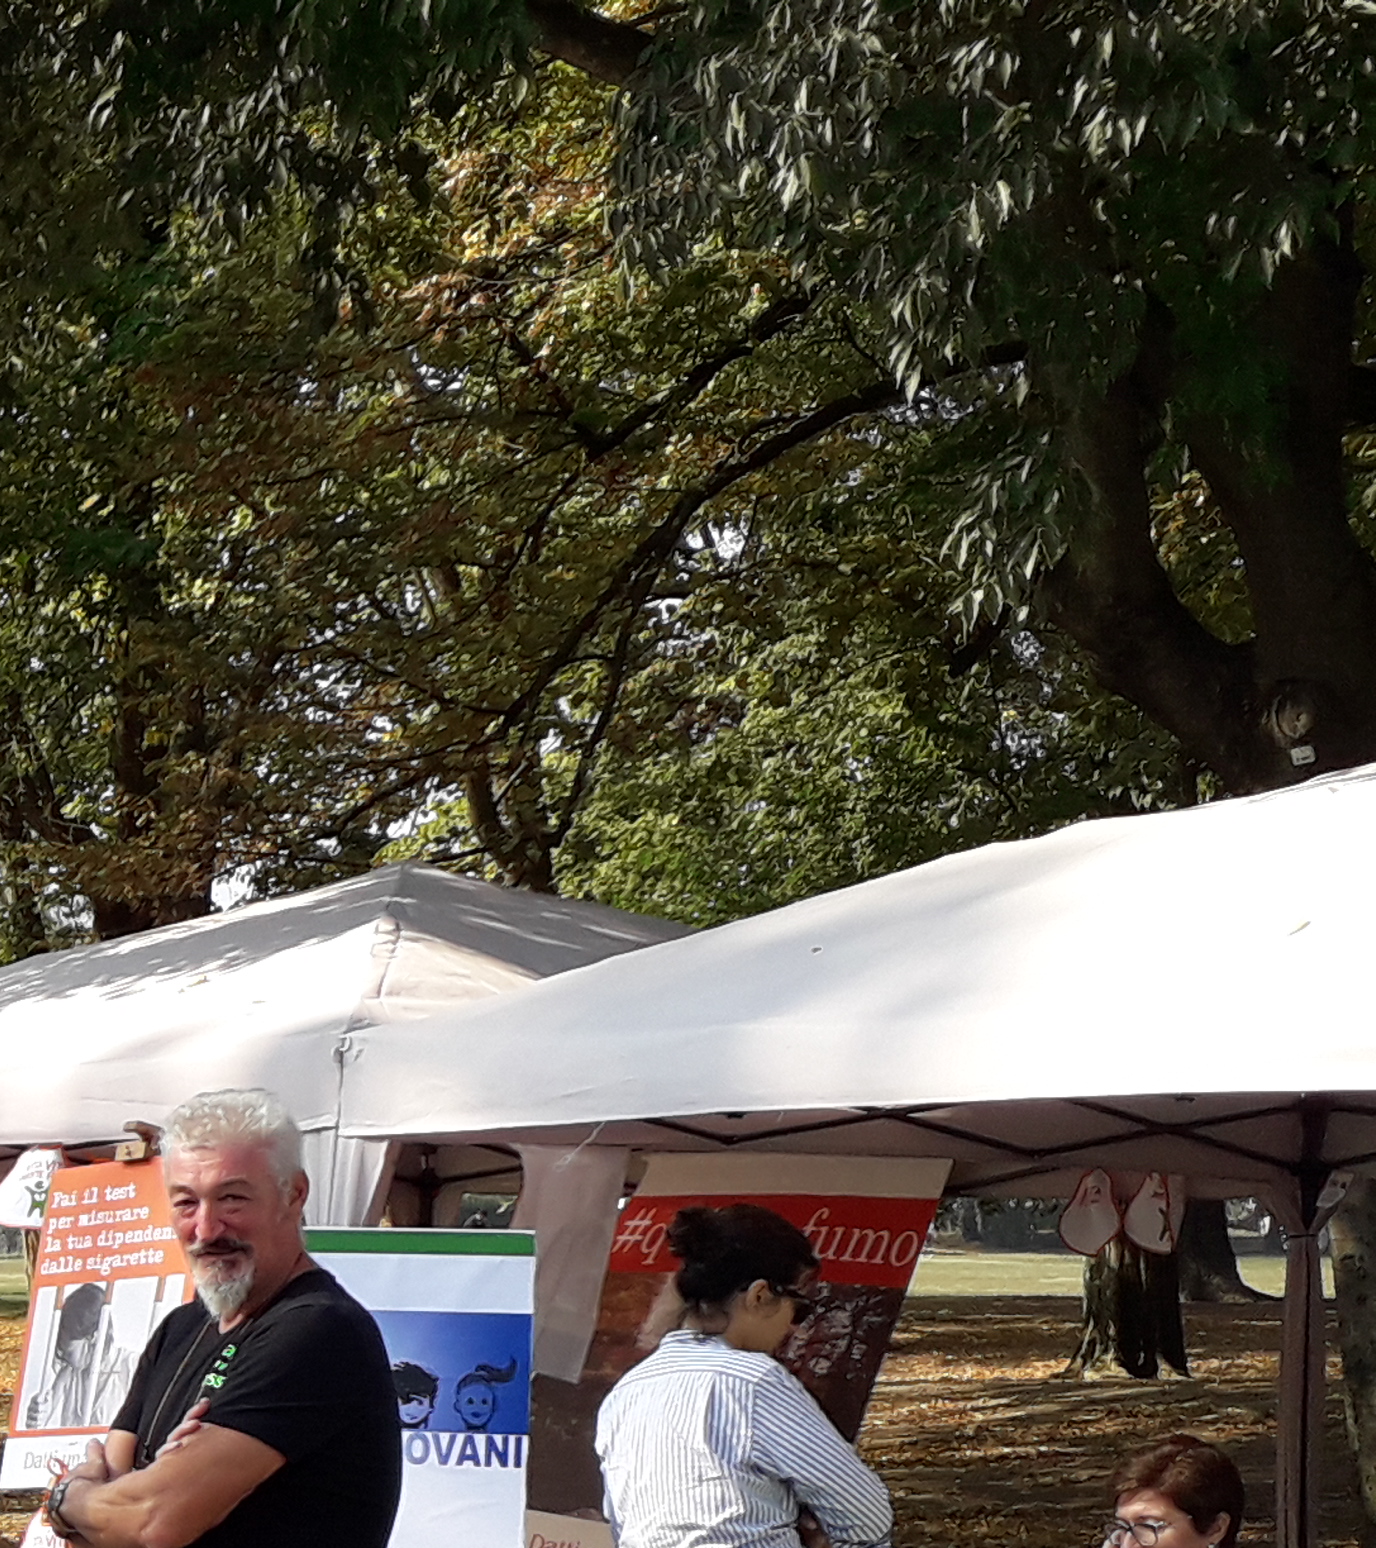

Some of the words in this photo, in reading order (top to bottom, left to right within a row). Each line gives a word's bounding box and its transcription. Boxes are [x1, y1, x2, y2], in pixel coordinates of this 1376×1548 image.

[51, 1191, 77, 1208] Fai
[81, 1187, 98, 1204] il
[104, 1182, 136, 1201] test
[47, 1216, 75, 1234] per
[78, 1206, 150, 1227] misurare
[44, 1236, 61, 1253] la
[67, 1234, 93, 1250] tua
[41, 1258, 82, 1275] dalle
[86, 1249, 164, 1276] sigarette
[405, 1432, 523, 1469] OVANI
